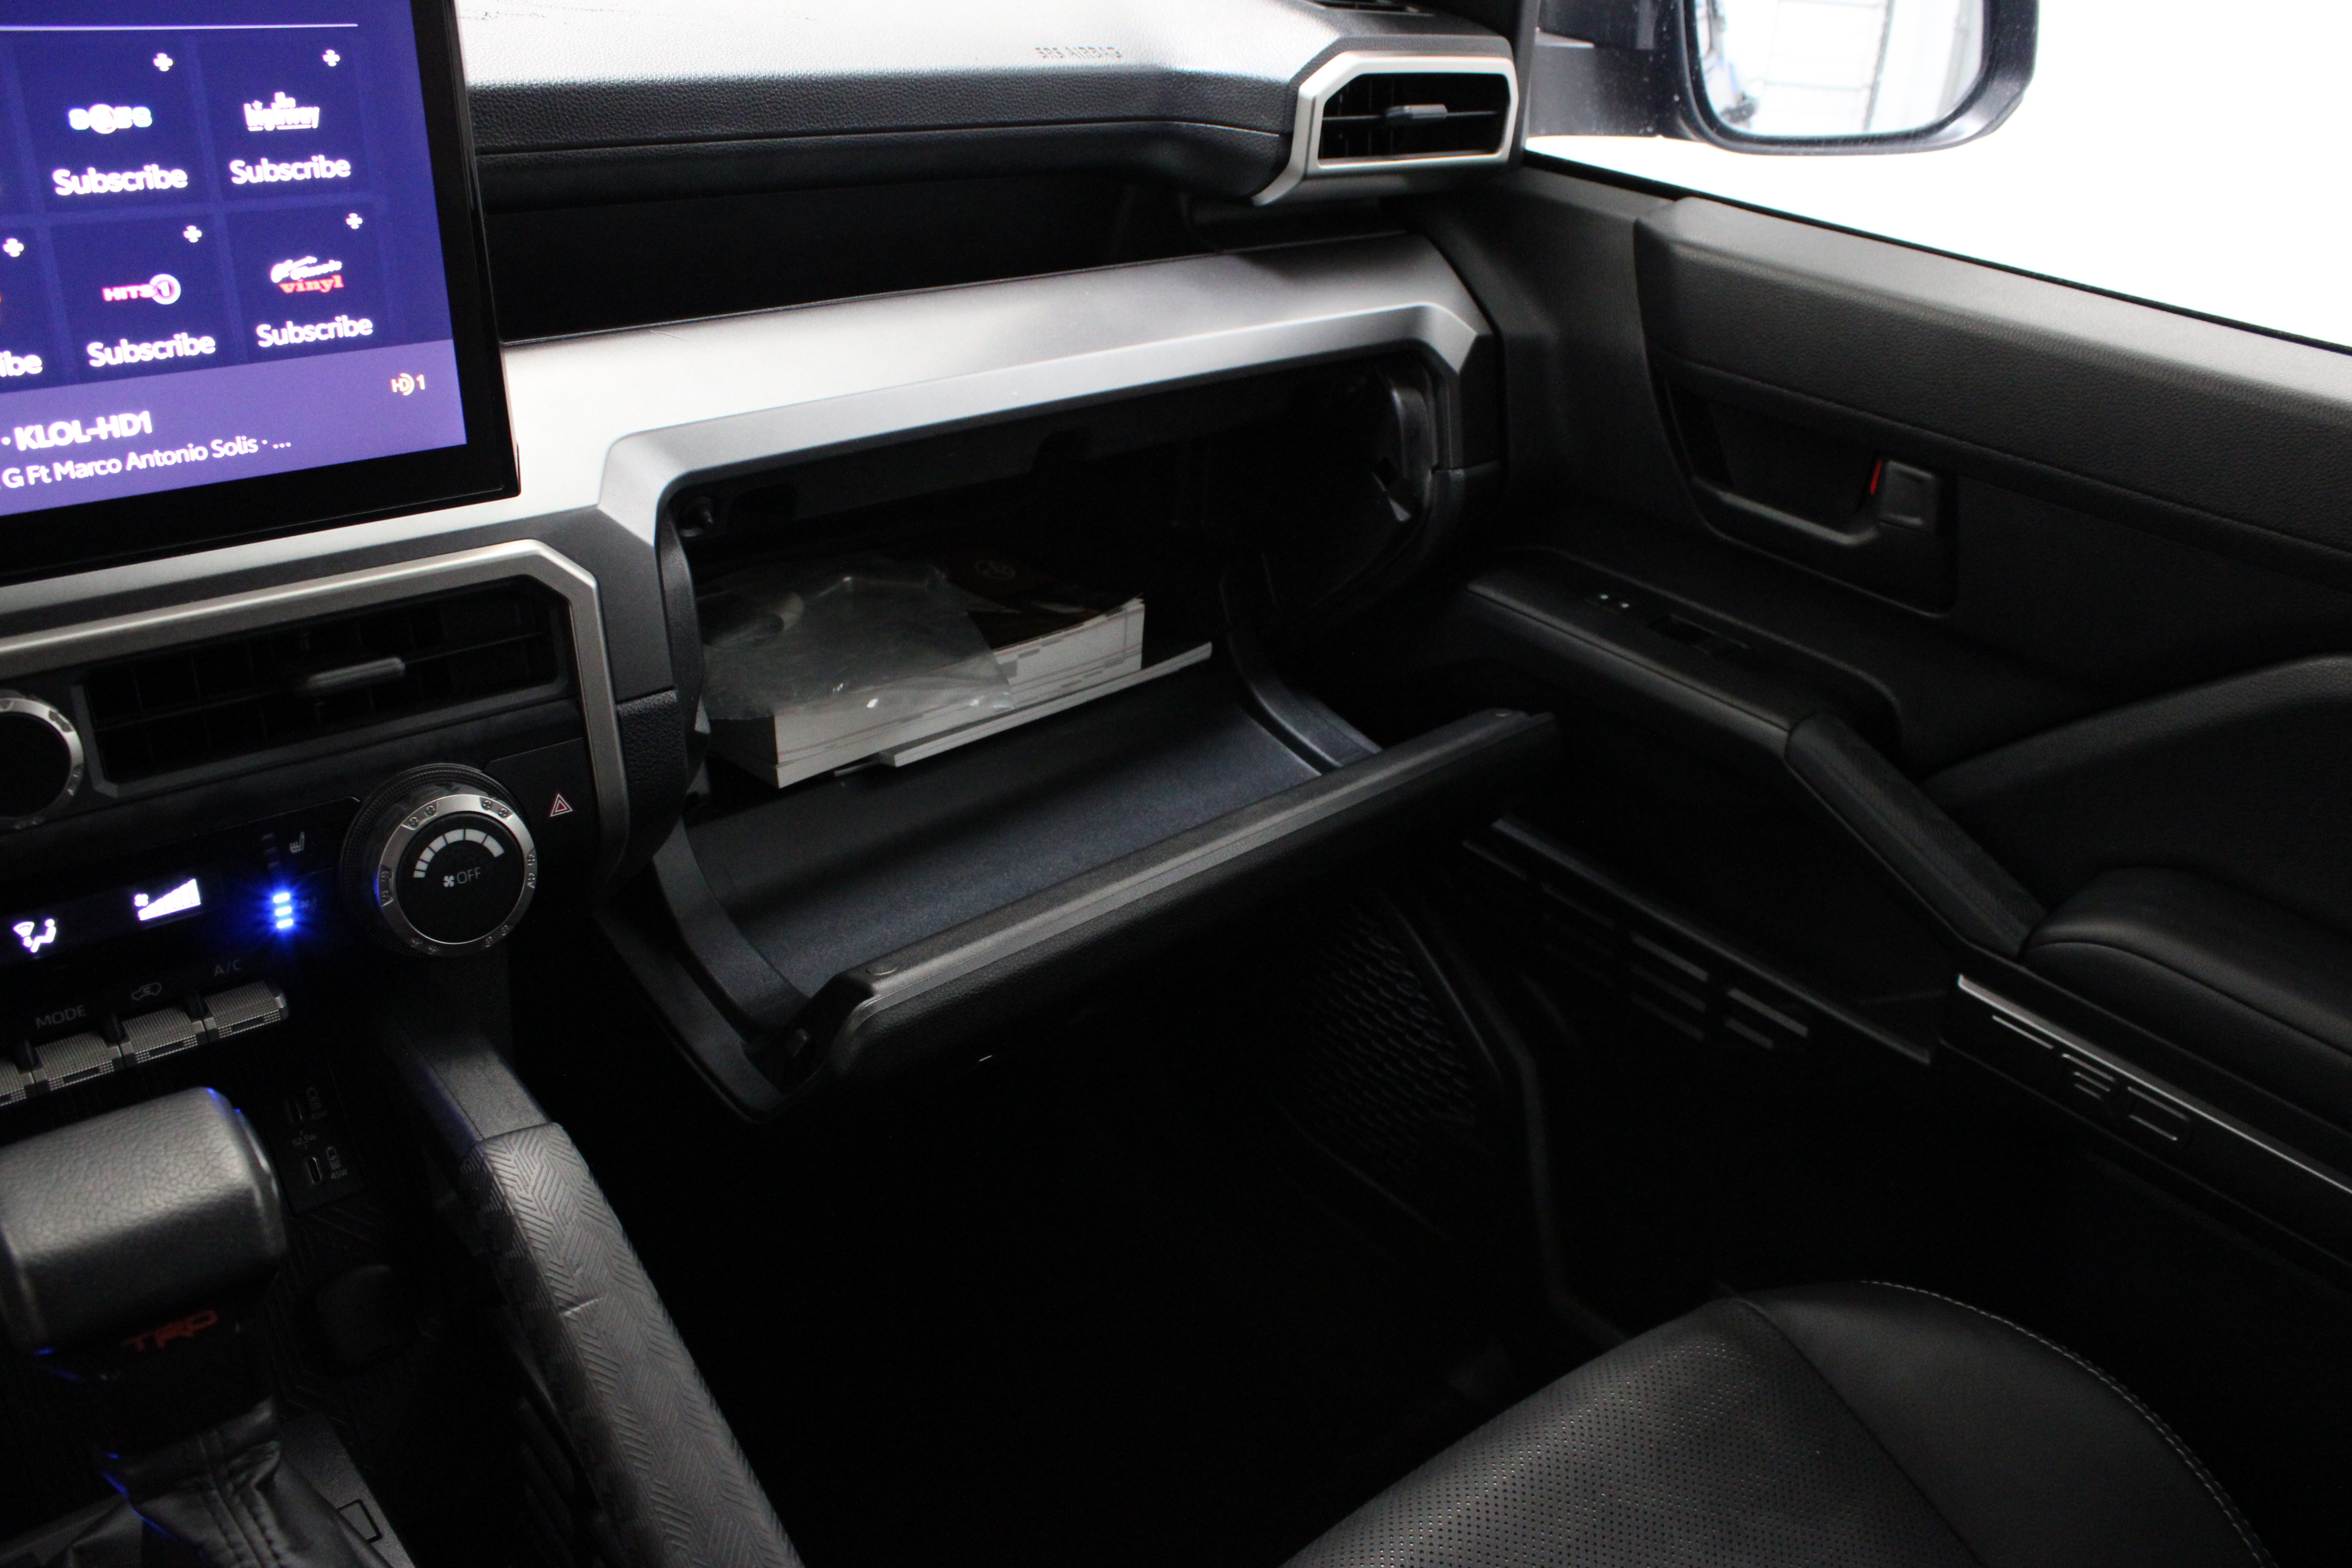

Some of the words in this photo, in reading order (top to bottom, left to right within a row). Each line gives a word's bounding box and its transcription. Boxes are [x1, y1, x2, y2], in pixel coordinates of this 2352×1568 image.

[53, 164, 188, 196] Subscribe
[229, 155, 351, 184] Subscribe
[278, 274, 345, 294] vinyl
[256, 315, 373, 347] Subscribe
[87, 332, 216, 367] Subscribe
[15, 411, 153, 451] KLOL-HD1
[2, 468, 24, 489] G
[26, 465, 52, 485] Ft
[53, 458, 122, 481] Marco
[126, 443, 207, 471] Antonio
[210, 436, 259, 458] Solis
[456, 867, 481, 885] OFF
[213, 959, 243, 978] A/C
[35, 1004, 86, 1029] MODE
